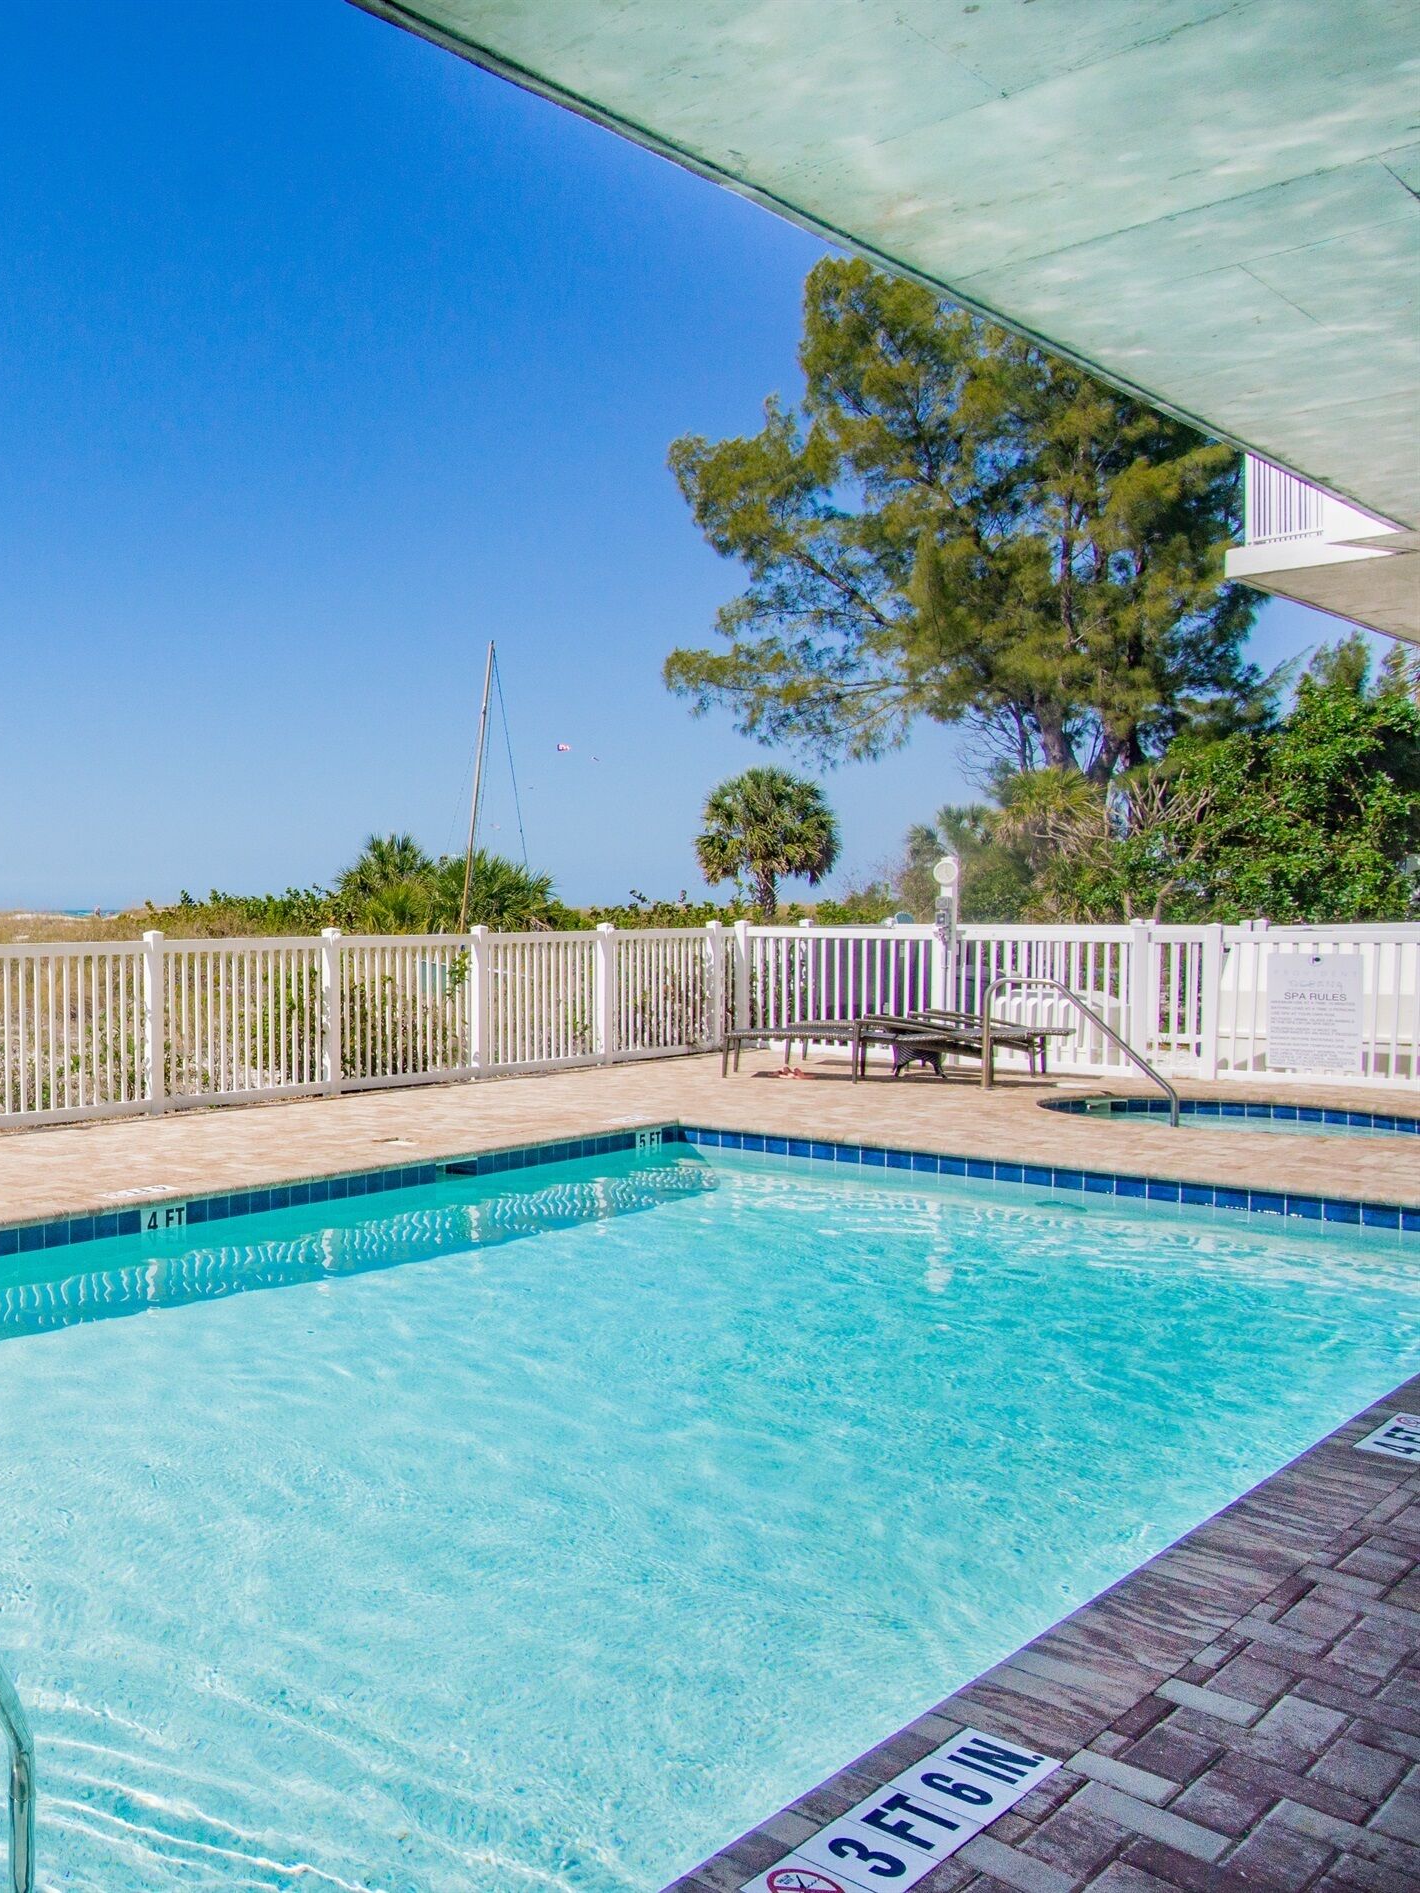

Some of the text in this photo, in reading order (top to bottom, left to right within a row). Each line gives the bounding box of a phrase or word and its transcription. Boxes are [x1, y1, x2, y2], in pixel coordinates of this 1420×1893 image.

[1284, 992, 1347, 1001] SPA RULES
[639, 1131, 661, 1148] 5 FT
[147, 1206, 185, 1230] 4 FT
[828, 1737, 1046, 1878] 3 FT 6 IN.
